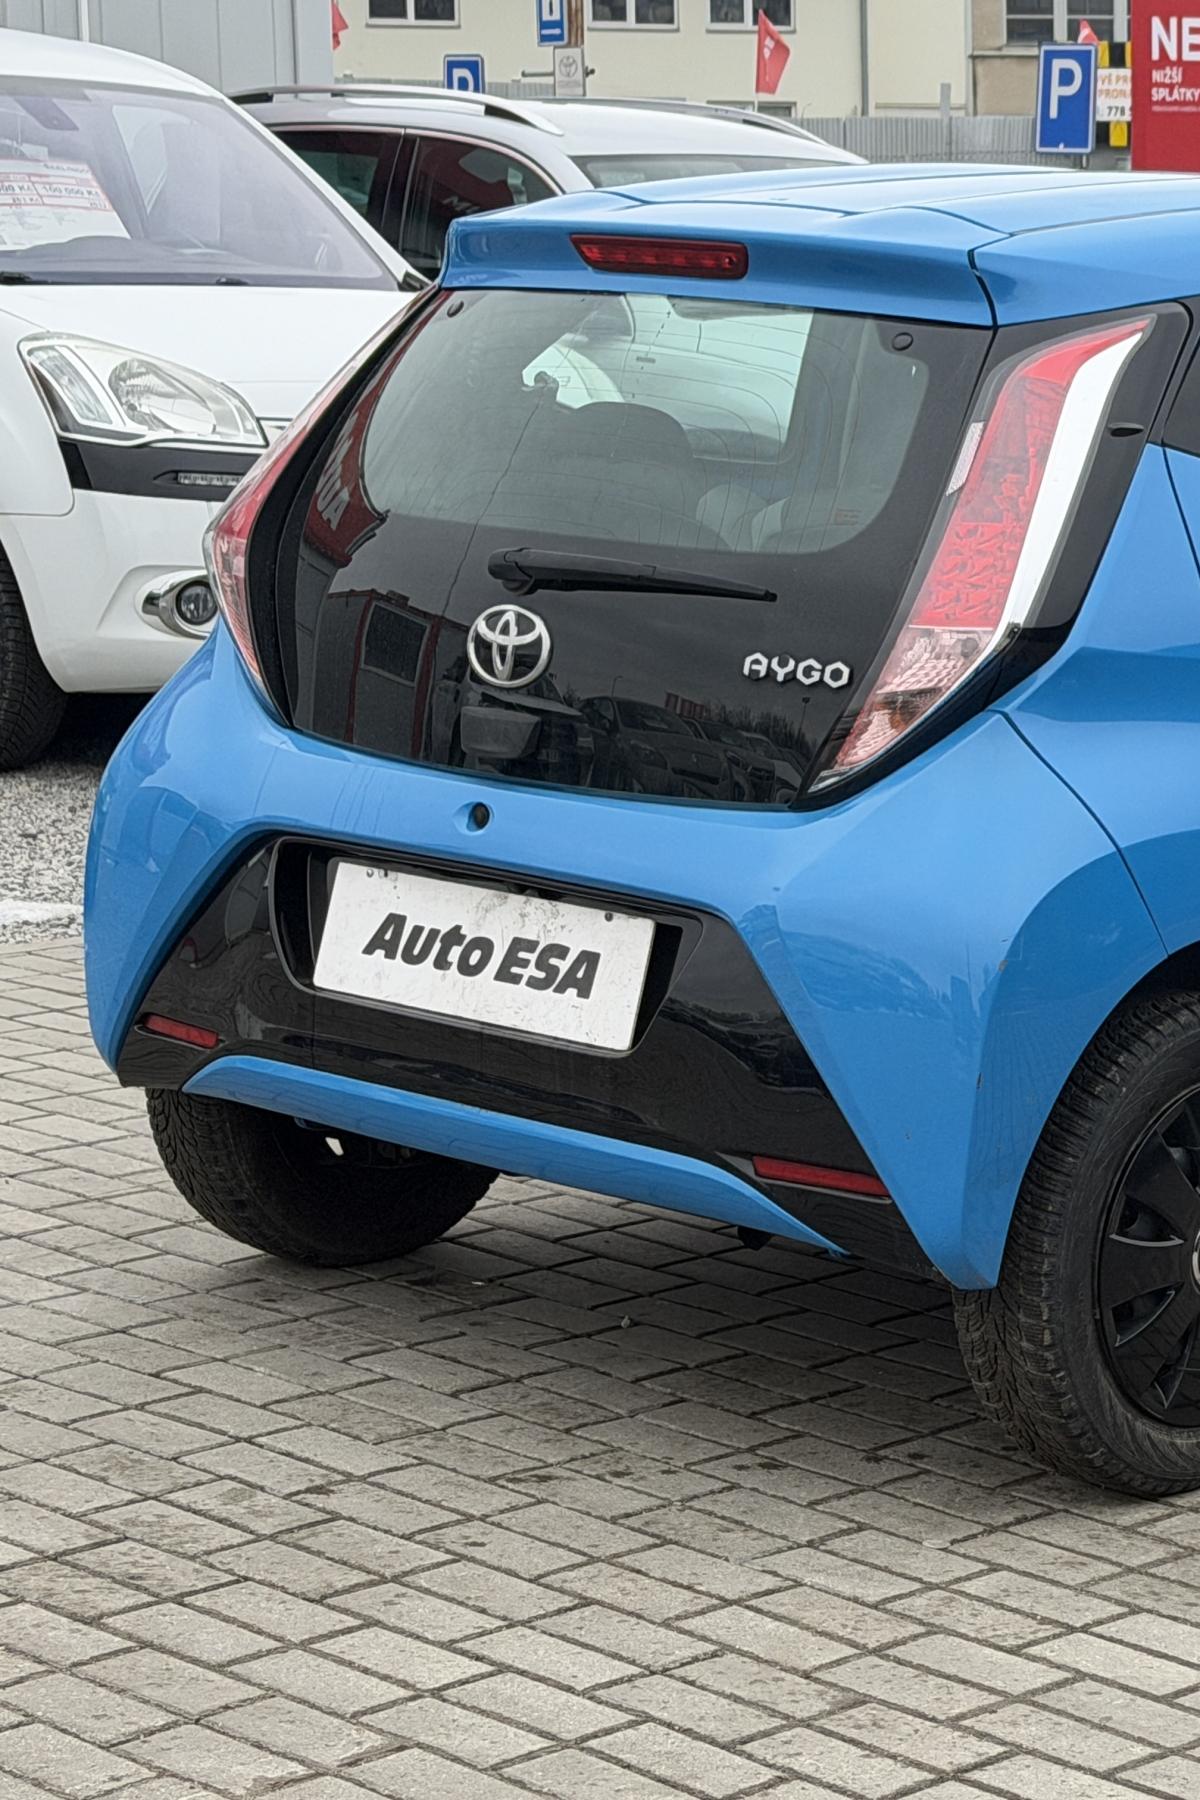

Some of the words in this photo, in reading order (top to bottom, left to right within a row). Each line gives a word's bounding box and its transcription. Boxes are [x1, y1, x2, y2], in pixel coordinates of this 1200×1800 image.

[1050, 58, 1083, 119] P
[1152, 66, 1182, 83] NIŽŠÍ
[1151, 84, 1200, 102] SPLÁTKY
[743, 652, 850, 688] AYGO
[361, 912, 494, 977] Auto
[493, 936, 601, 999] ESA
